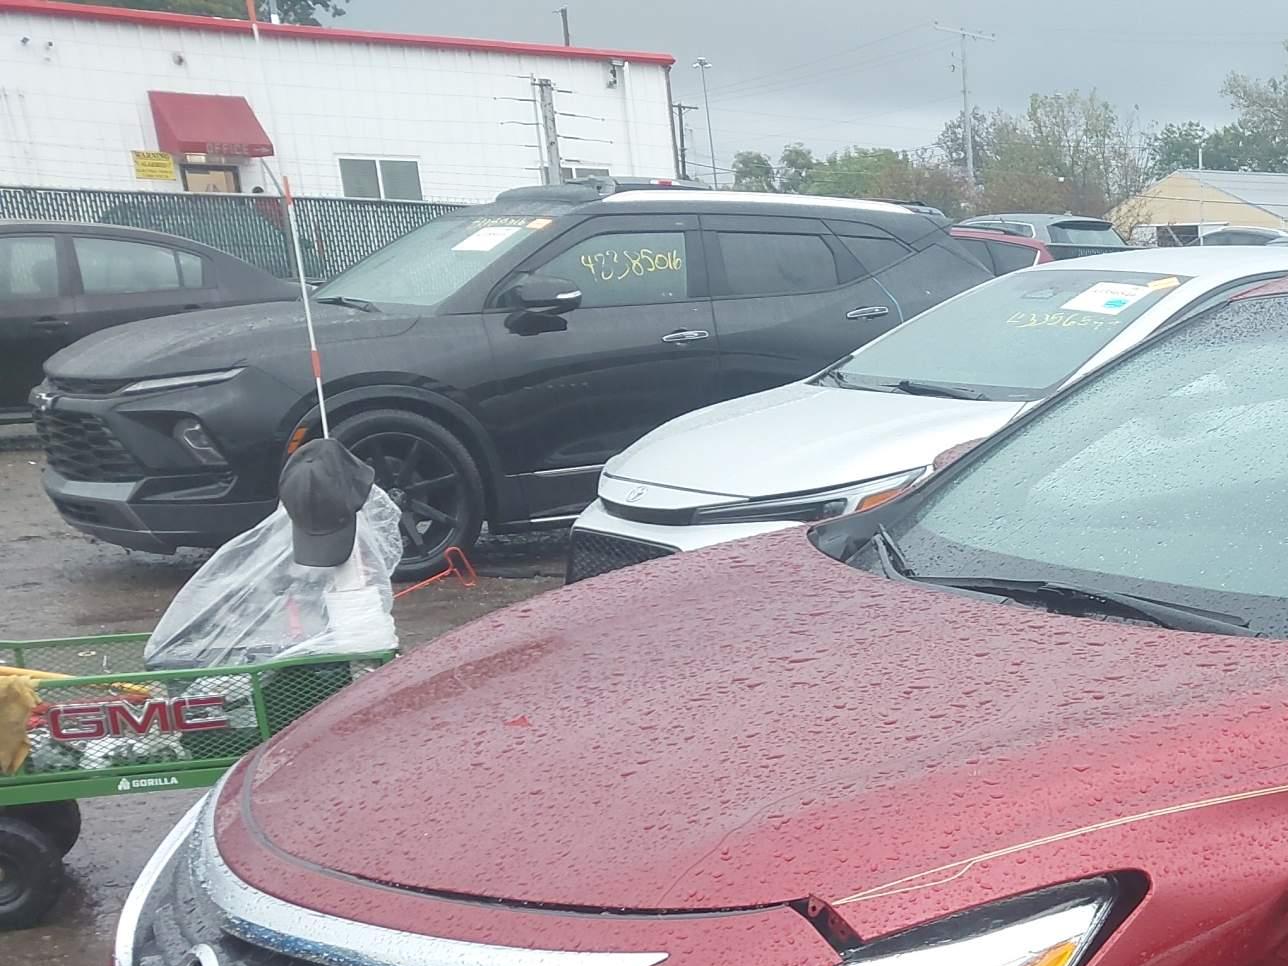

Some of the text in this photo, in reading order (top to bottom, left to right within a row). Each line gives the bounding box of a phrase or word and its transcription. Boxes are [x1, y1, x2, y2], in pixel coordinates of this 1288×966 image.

[206, 142, 249, 154] OFFICE
[49, 694, 230, 742] GMC
[131, 776, 179, 789] GORILLA
